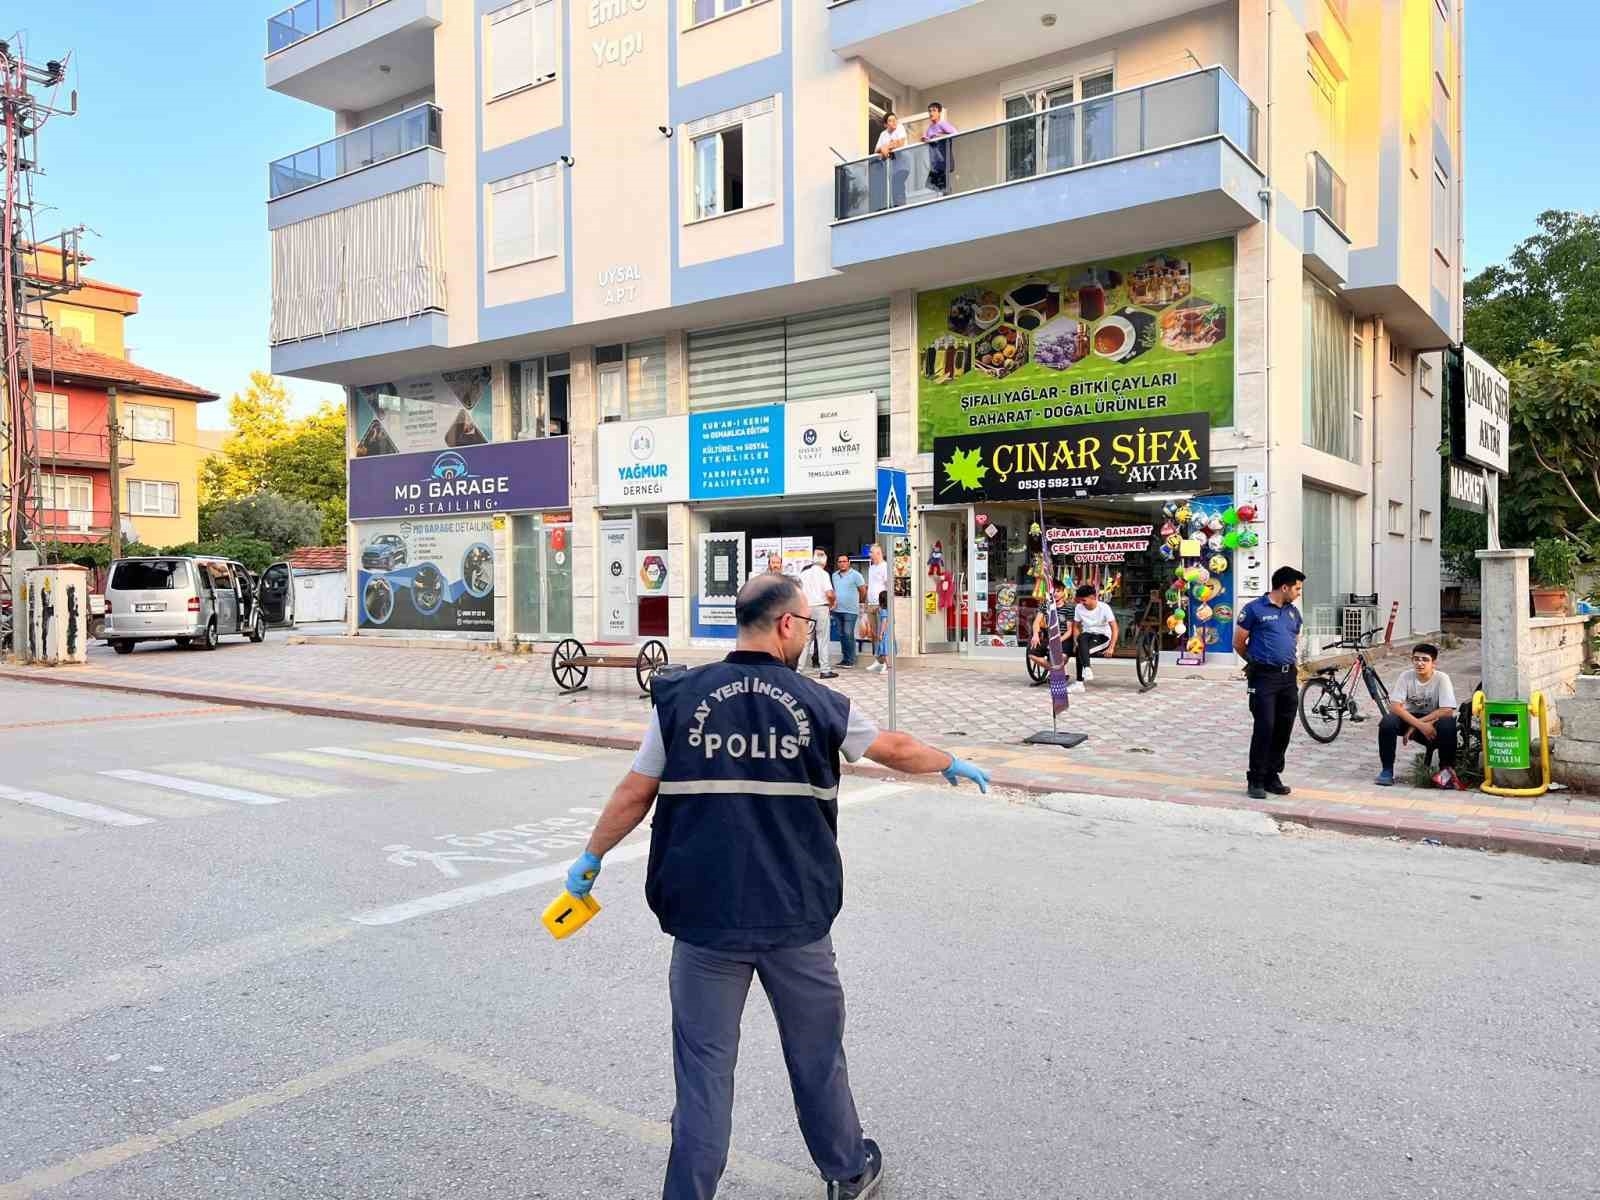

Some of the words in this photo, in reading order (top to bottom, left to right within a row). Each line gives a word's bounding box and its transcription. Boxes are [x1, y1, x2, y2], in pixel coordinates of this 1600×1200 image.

[599, 264, 641, 288] UYSAL
[1003, 386, 1058, 403] YAĞLAR
[1070, 377, 1108, 396] BİTKİ
[1111, 372, 1177, 395] ÇAYLARI
[1465, 361, 1494, 415] ÇINAR
[969, 409, 1032, 426] BAHARAT
[1044, 403, 1091, 419] DOĞAL
[1095, 395, 1167, 413] ÜRÜNLER
[831, 443, 861, 453] HAYRAT
[992, 437, 1101, 482] ÇINAR
[1111, 427, 1200, 474] ŞİFA
[618, 463, 668, 480] YAĞMUR
[1018, 479, 1046, 490] 0536
[1047, 478, 1069, 489] 592
[1071, 476, 1083, 487] 11
[1084, 475, 1100, 486] 47
[1127, 463, 1198, 483] AKTAR
[394, 484, 421, 500] MD
[429, 476, 509, 498] GARAGE
[1450, 465, 1484, 505] MARKET
[1069, 528, 1100, 538] AKTAR
[1105, 526, 1153, 537] BAHARAT
[1074, 552, 1125, 563] OYUNCAK
[1106, 540, 1149, 552] MARKET
[688, 700, 711, 747] OLAY
[705, 726, 799, 759] POLİS
[554, 908, 573, 925] 1
